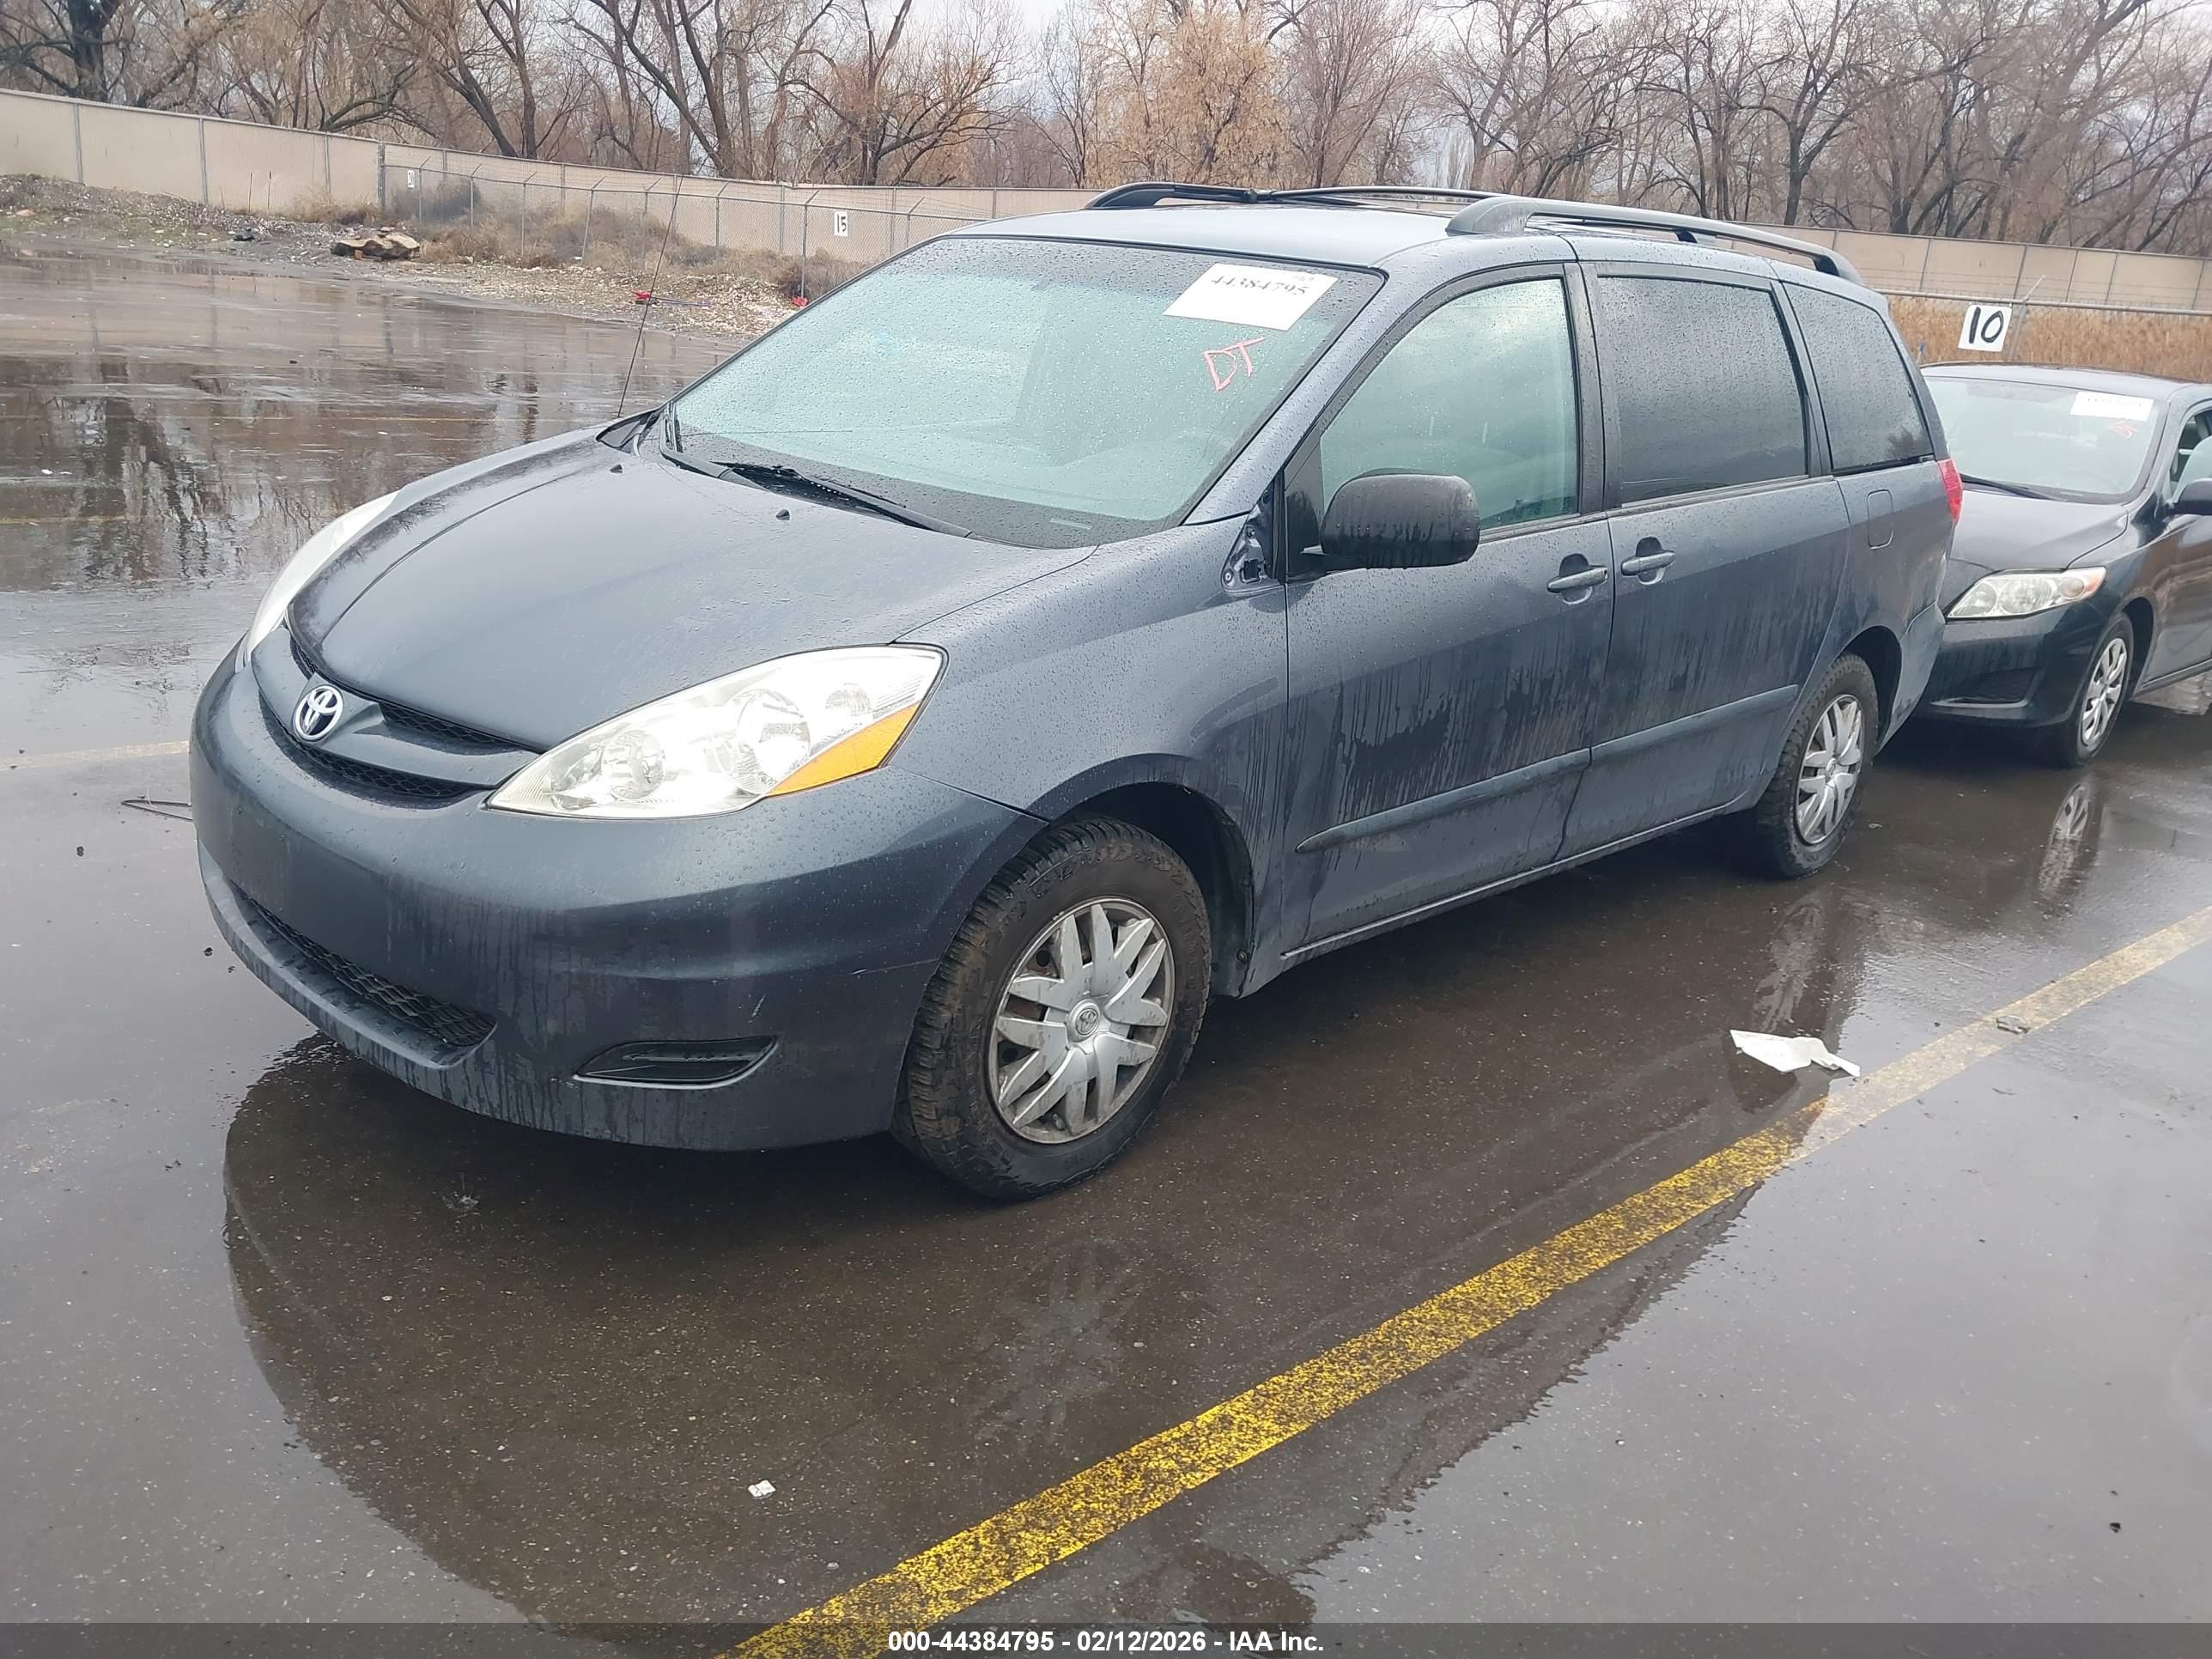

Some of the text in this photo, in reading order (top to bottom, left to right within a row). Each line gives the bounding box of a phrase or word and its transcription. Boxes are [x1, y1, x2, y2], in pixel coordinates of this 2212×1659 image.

[837, 214, 847, 233] 15
[1211, 276, 1310, 295] 44384795
[1968, 306, 2004, 344] 10
[1202, 336, 1266, 392] DT
